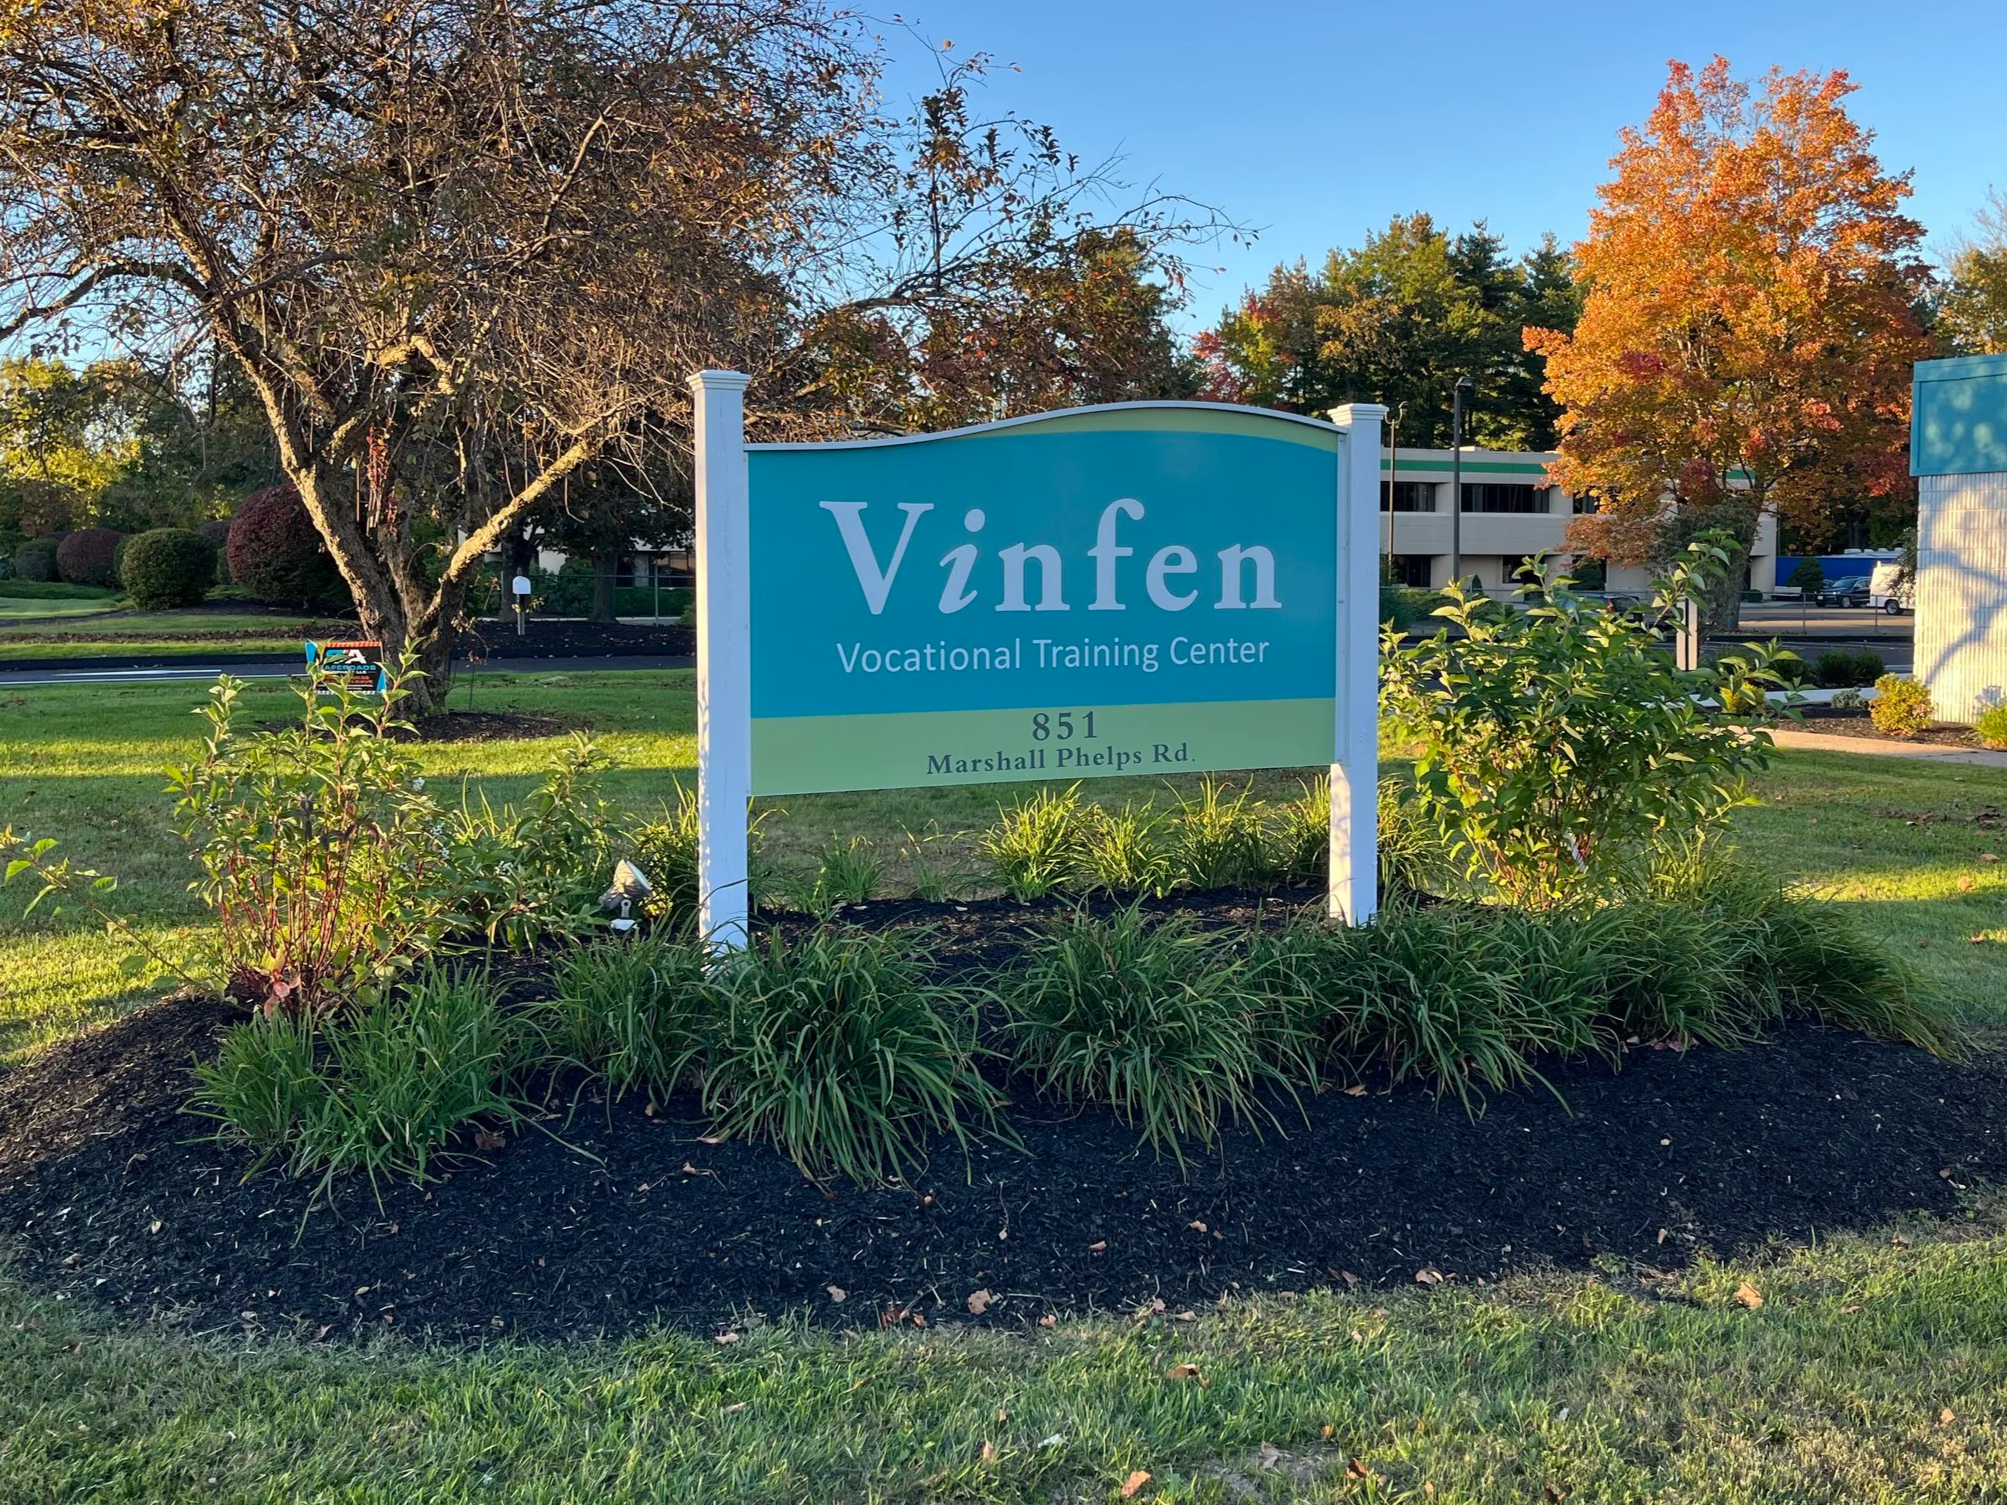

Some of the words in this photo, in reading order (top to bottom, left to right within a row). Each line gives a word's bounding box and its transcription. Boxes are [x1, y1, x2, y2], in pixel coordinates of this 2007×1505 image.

[819, 497, 1282, 615] Vinfen
[837, 638, 1021, 673] Vocational
[1033, 637, 1160, 672] Training
[1170, 636, 1270, 665] Center
[1032, 711, 1098, 741] 851
[926, 750, 1046, 775] Marshall
[1056, 746, 1143, 770] Phelps
[1152, 742, 1196, 763] Rd.
